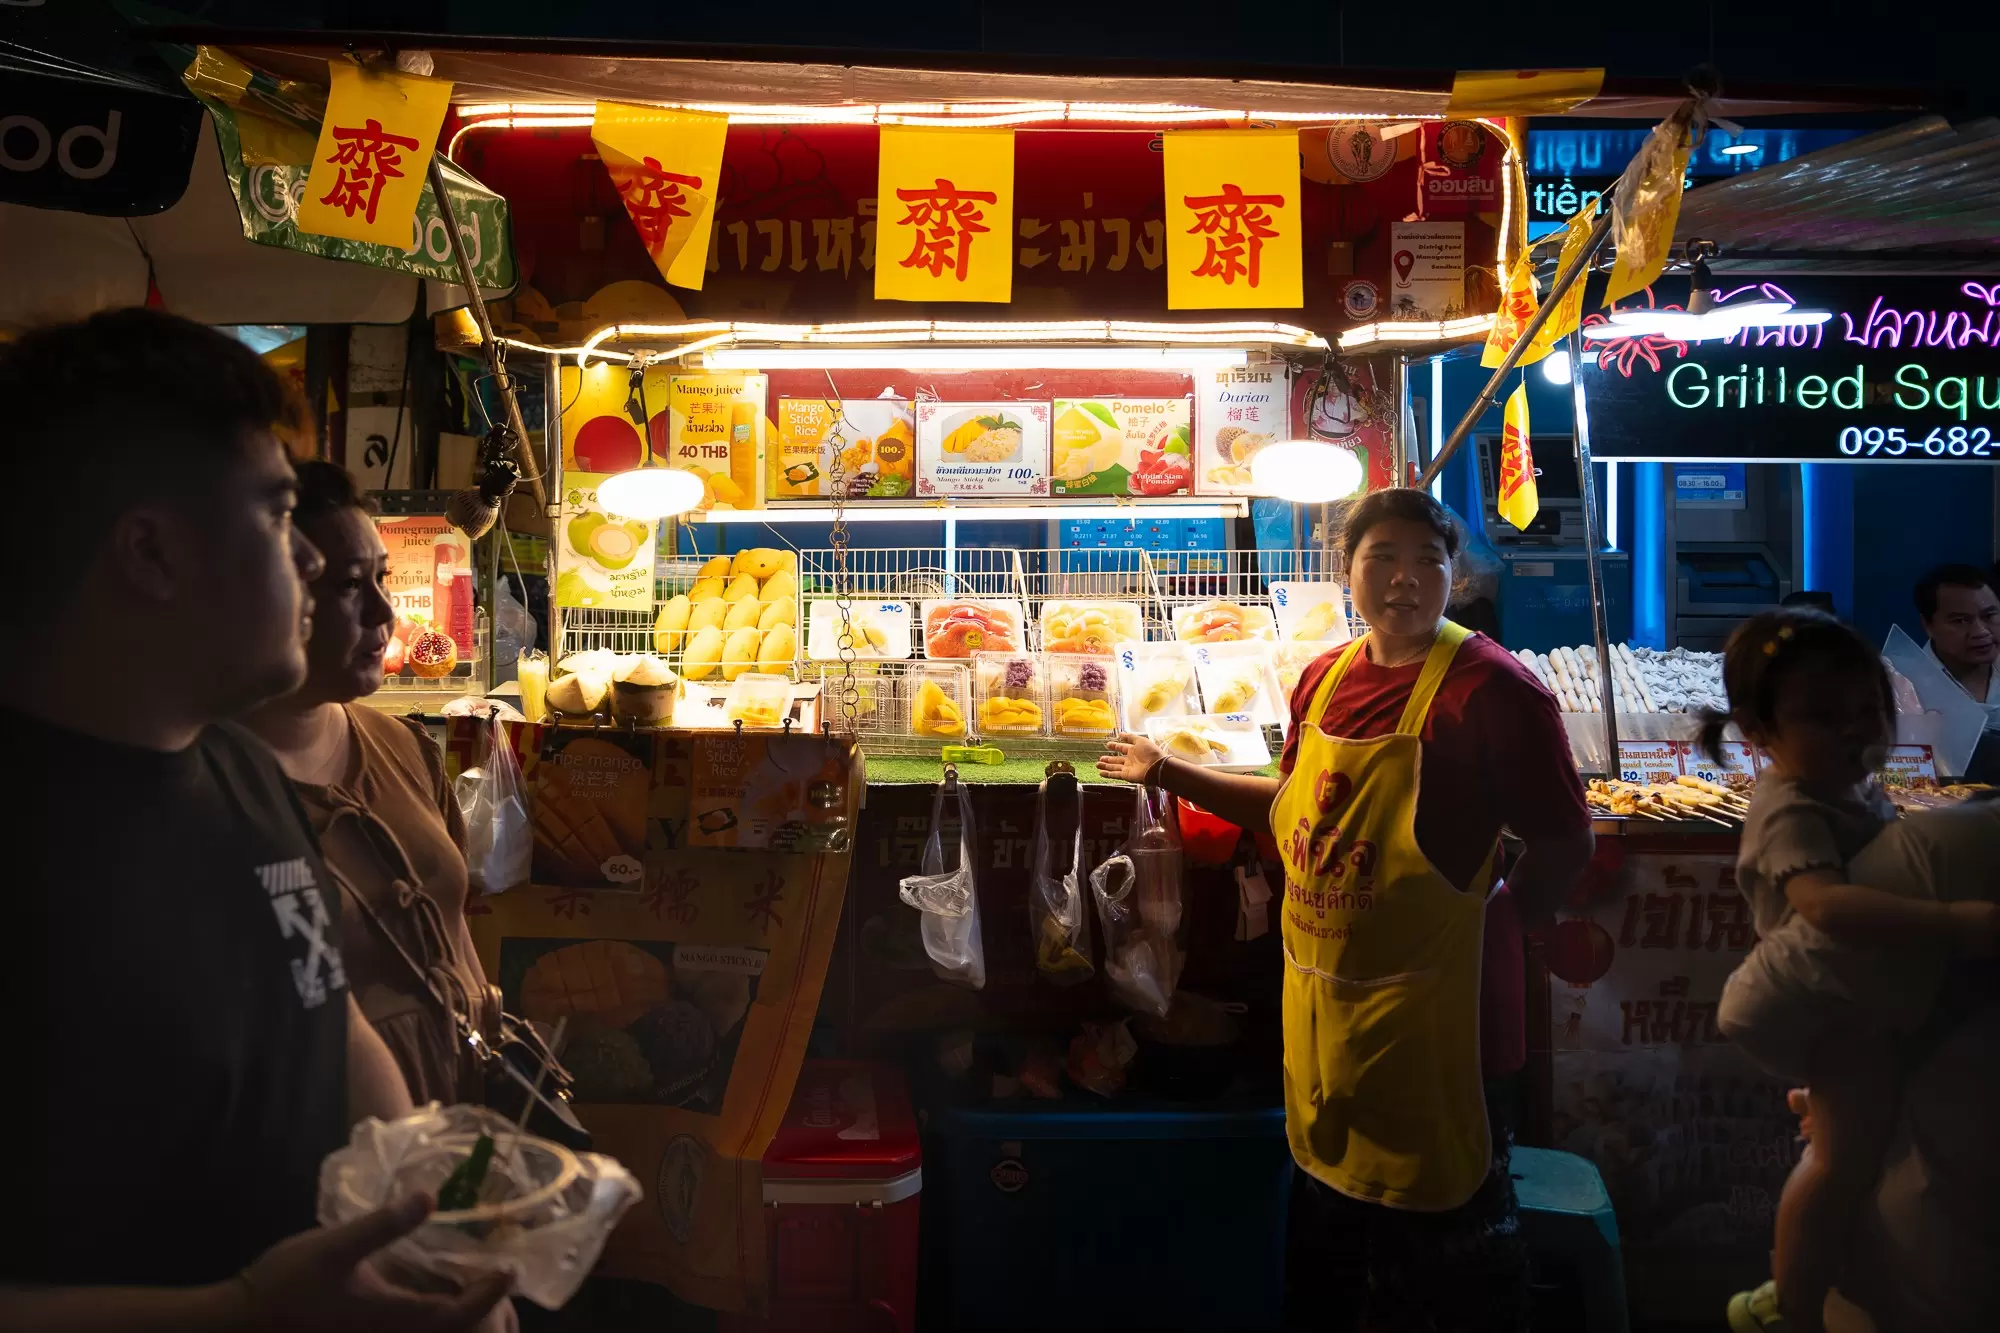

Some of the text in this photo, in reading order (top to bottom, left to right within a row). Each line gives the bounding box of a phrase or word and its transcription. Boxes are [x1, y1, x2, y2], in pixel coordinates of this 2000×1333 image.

[676, 384, 742, 396] Mango juice
[1666, 362, 2000, 421] Grilled Squ
[1219, 391, 1270, 403] Durian
[689, 402, 726, 415] 芒果汁
[787, 402, 825, 416] Mango
[1113, 402, 1165, 414] Pomelo
[1226, 406, 1260, 422] 榴莲
[686, 415, 725, 433] น้ำมะม่วง
[789, 413, 823, 426] Sticky
[1128, 416, 1150, 428] 柚子
[794, 425, 818, 436] Rice
[1125, 429, 1146, 439] ส้มโอ
[678, 445, 728, 459] 40 THB
[1007, 468, 1040, 479] 100.-
[379, 526, 455, 538] Pomegranate
[401, 536, 431, 548] juice
[403, 595, 432, 608] THB
[704, 737, 747, 754] Mango
[552, 750, 643, 773] ripe mango
[706, 750, 745, 766] Sticky
[712, 764, 738, 776] Rice
[1619, 760, 1641, 769] quid
[680, 952, 717, 963] MANGO
